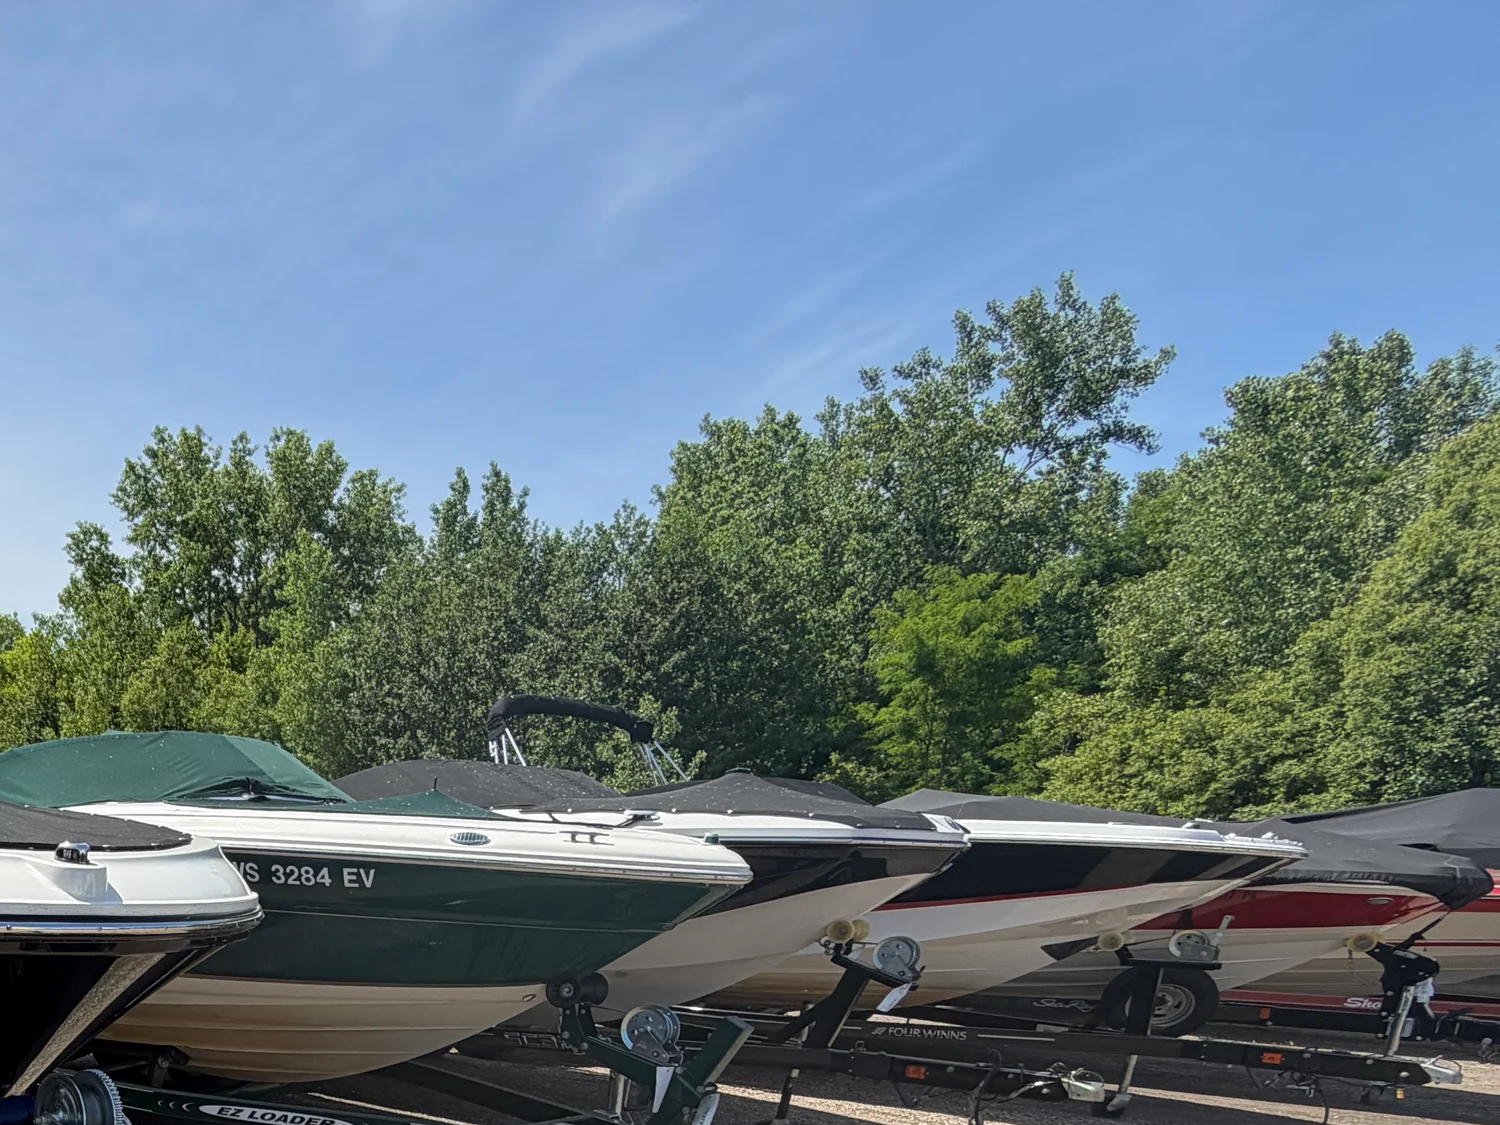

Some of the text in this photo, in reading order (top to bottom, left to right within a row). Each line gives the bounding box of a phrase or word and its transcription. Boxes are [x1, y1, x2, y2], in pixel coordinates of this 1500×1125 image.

[270, 864, 332, 887] 3284
[342, 867, 376, 888] EV
[887, 1026, 967, 1041] FOUR WINNS
[216, 1106, 241, 1117] EZ
